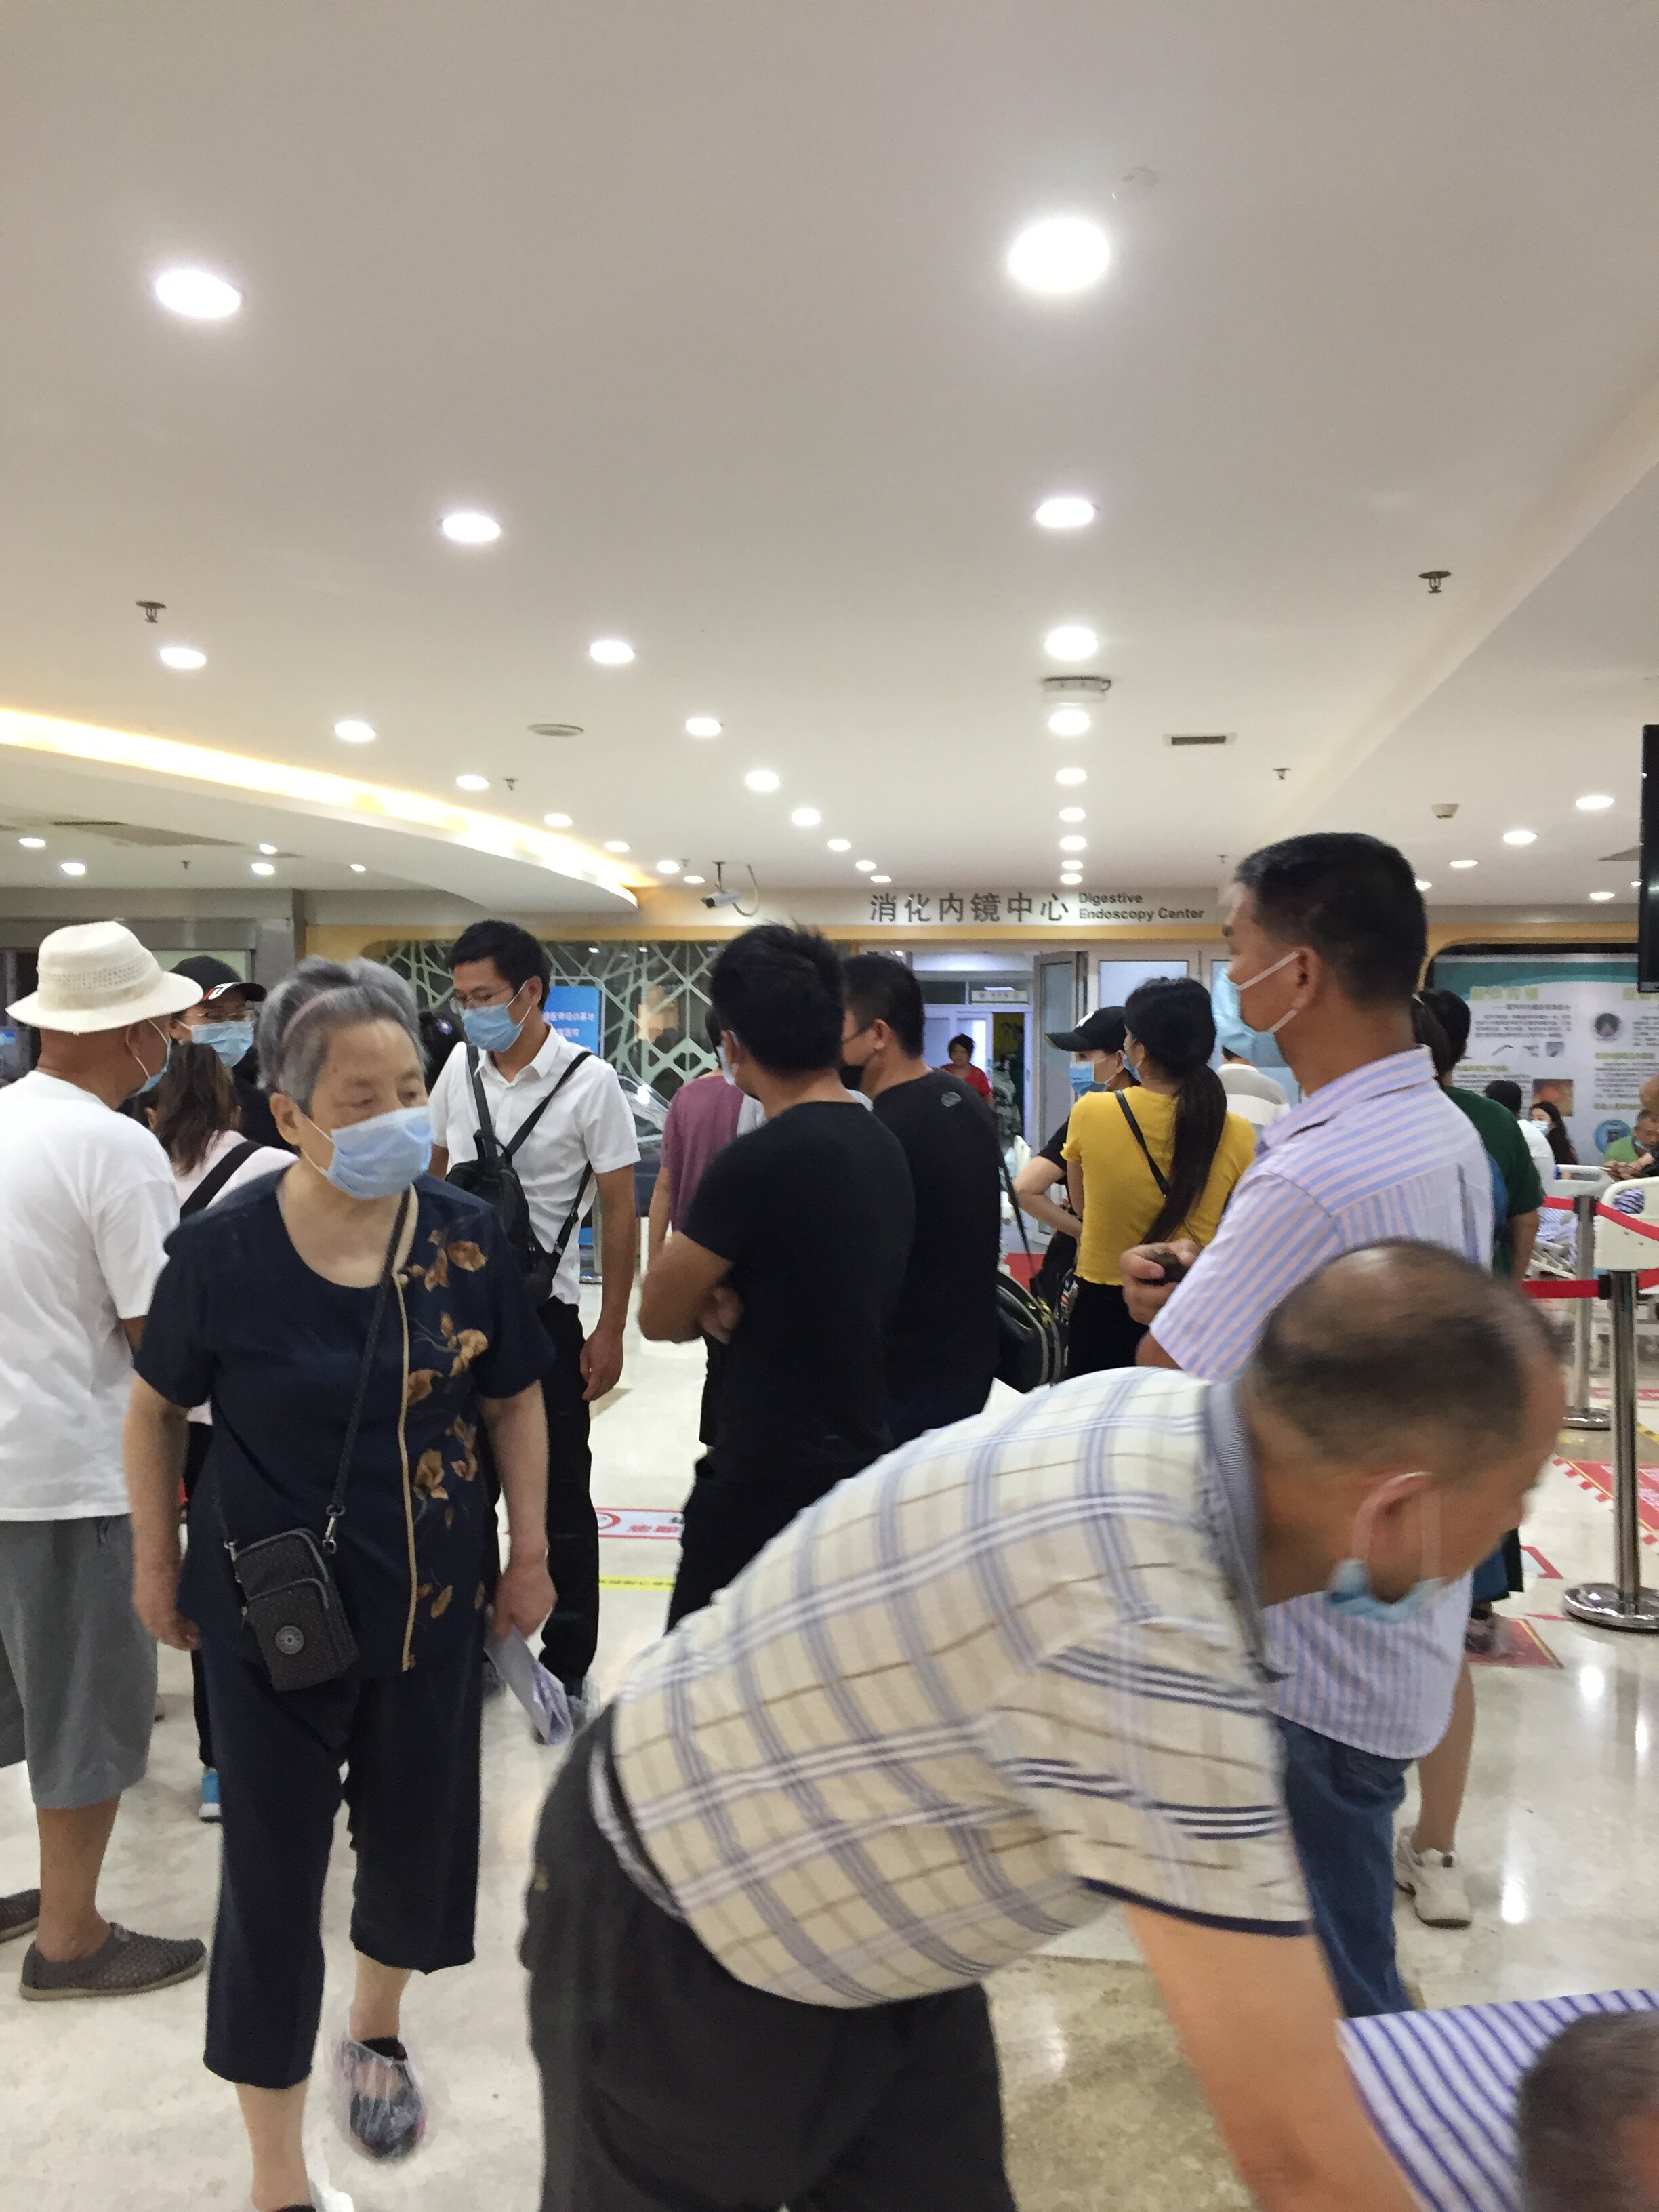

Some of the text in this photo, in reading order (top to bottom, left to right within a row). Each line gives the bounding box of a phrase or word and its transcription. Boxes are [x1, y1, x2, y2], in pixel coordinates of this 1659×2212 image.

[869, 892, 1069, 922] 消化内镜中心
[1078, 892, 1143, 907] Digestive
[1079, 907, 1205, 922] Endoscopy Center
